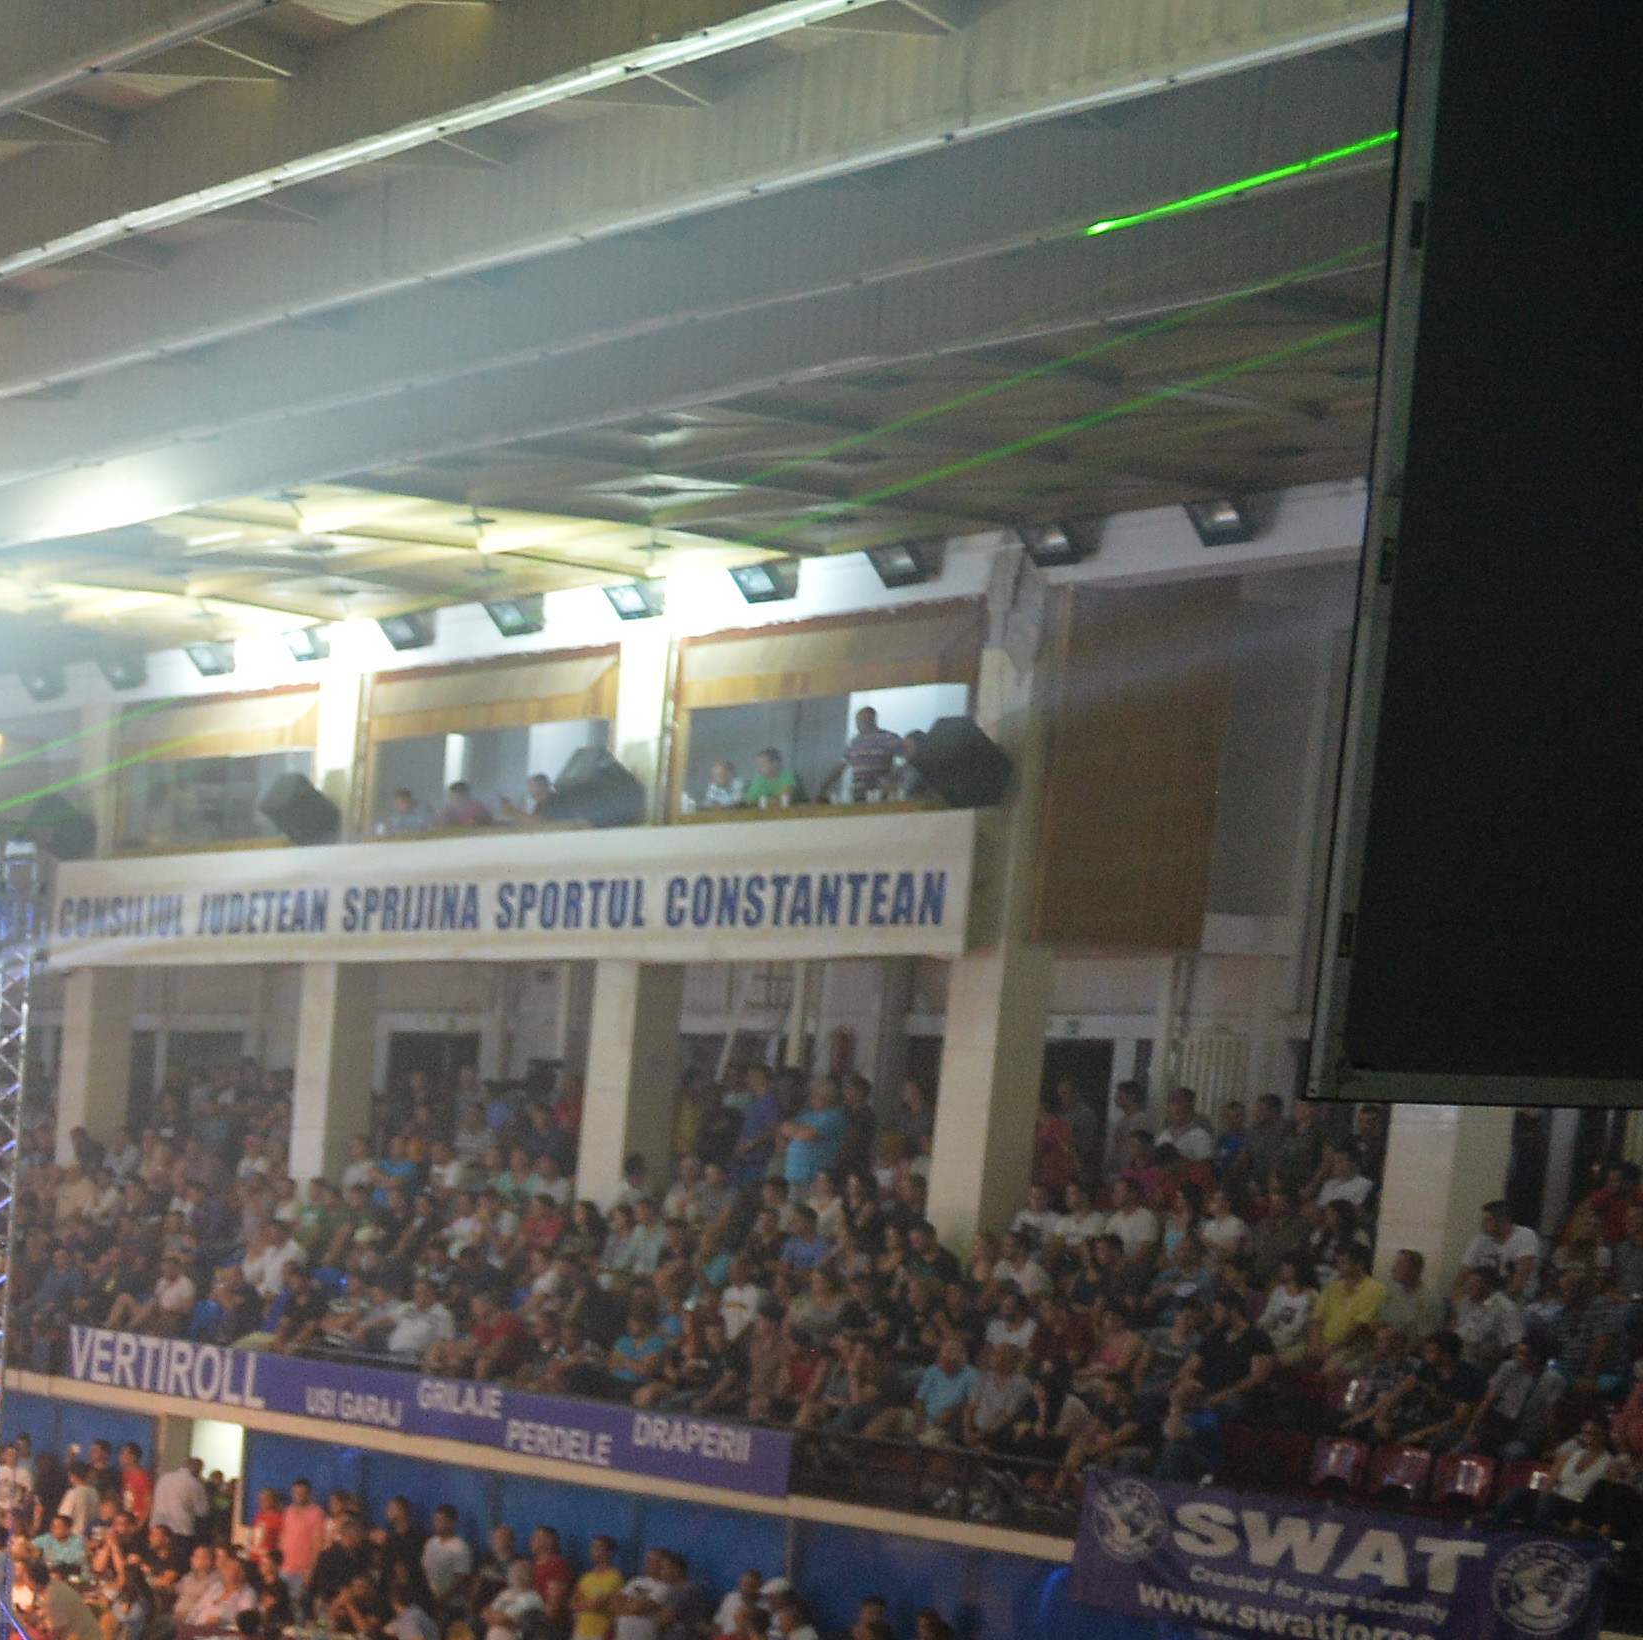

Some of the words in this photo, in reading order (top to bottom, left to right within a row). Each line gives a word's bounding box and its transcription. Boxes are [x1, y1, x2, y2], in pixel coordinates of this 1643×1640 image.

[58, 895, 185, 937] CONSILIUL
[198, 890, 328, 935] JUDETEAN
[342, 883, 480, 931] SPRIJINA
[495, 877, 645, 930] SPORTUL
[664, 870, 948, 928] CONSTANTEAN
[68, 1324, 267, 1410] VERTIROLL
[304, 1387, 338, 1417] USI
[338, 1389, 403, 1429] GARAJ
[417, 1378, 504, 1422] GRILAJE
[504, 1418, 614, 1468] PERDELE
[631, 1412, 753, 1465] DRAPERII
[1171, 1500, 1489, 1596] SWAT
[1189, 1563, 1272, 1597] Created
[1274, 1574, 1303, 1602] for
